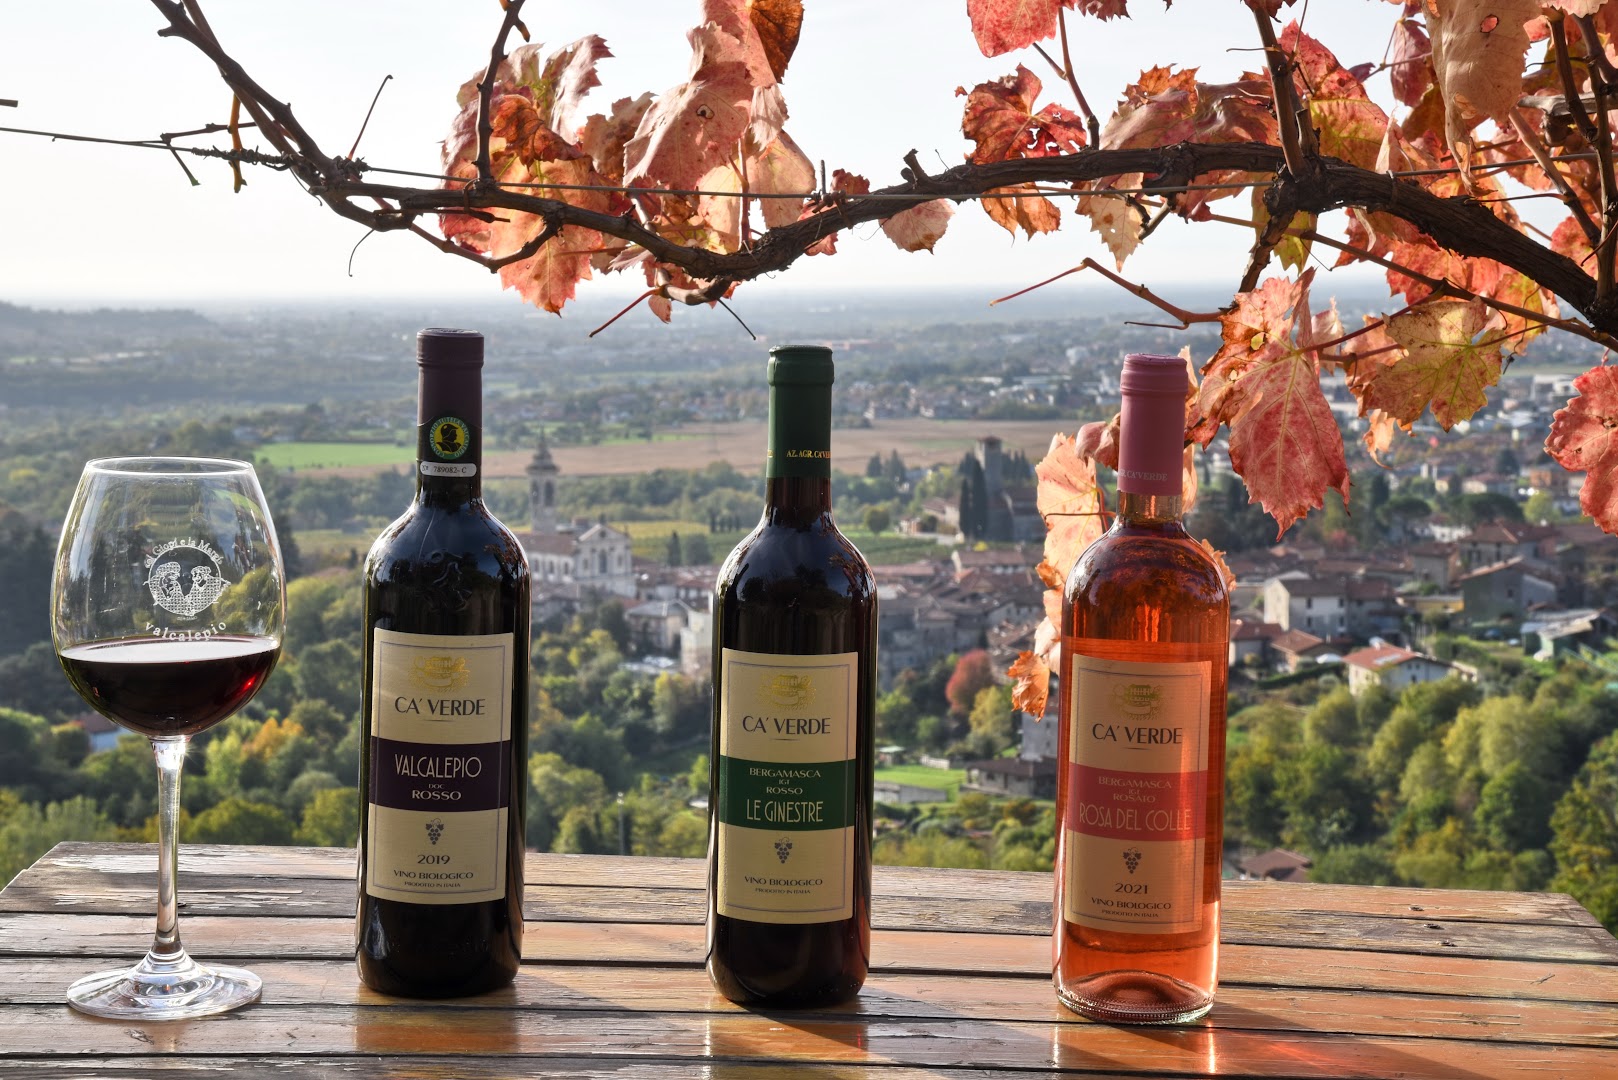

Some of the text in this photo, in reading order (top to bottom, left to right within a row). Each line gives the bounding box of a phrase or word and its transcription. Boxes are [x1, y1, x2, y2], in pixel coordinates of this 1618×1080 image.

[146, 622, 226, 642] valcalepio
[394, 696, 486, 716] CA' VERDE
[742, 715, 831, 734] CA' VERDE
[1092, 723, 1182, 744] CA' VERDE
[394, 753, 482, 778] VALCALEPIO
[749, 767, 822, 778] BERGAMASCA
[1098, 776, 1172, 789] BERGAMASCA
[411, 790, 462, 800] ROSSO
[766, 786, 803, 795] ROSSO
[1113, 793, 1156, 803] ROSATO
[746, 799, 824, 822] LE GINESTRE
[1080, 802, 1192, 831] ROSA DEL COLLE
[417, 854, 451, 864] 2019
[393, 869, 474, 880] VINO BIOLOGICO
[744, 876, 766, 885] VINO
[1114, 882, 1148, 894] 2021
[1091, 896, 1172, 910] VINO BIOLOGICO
